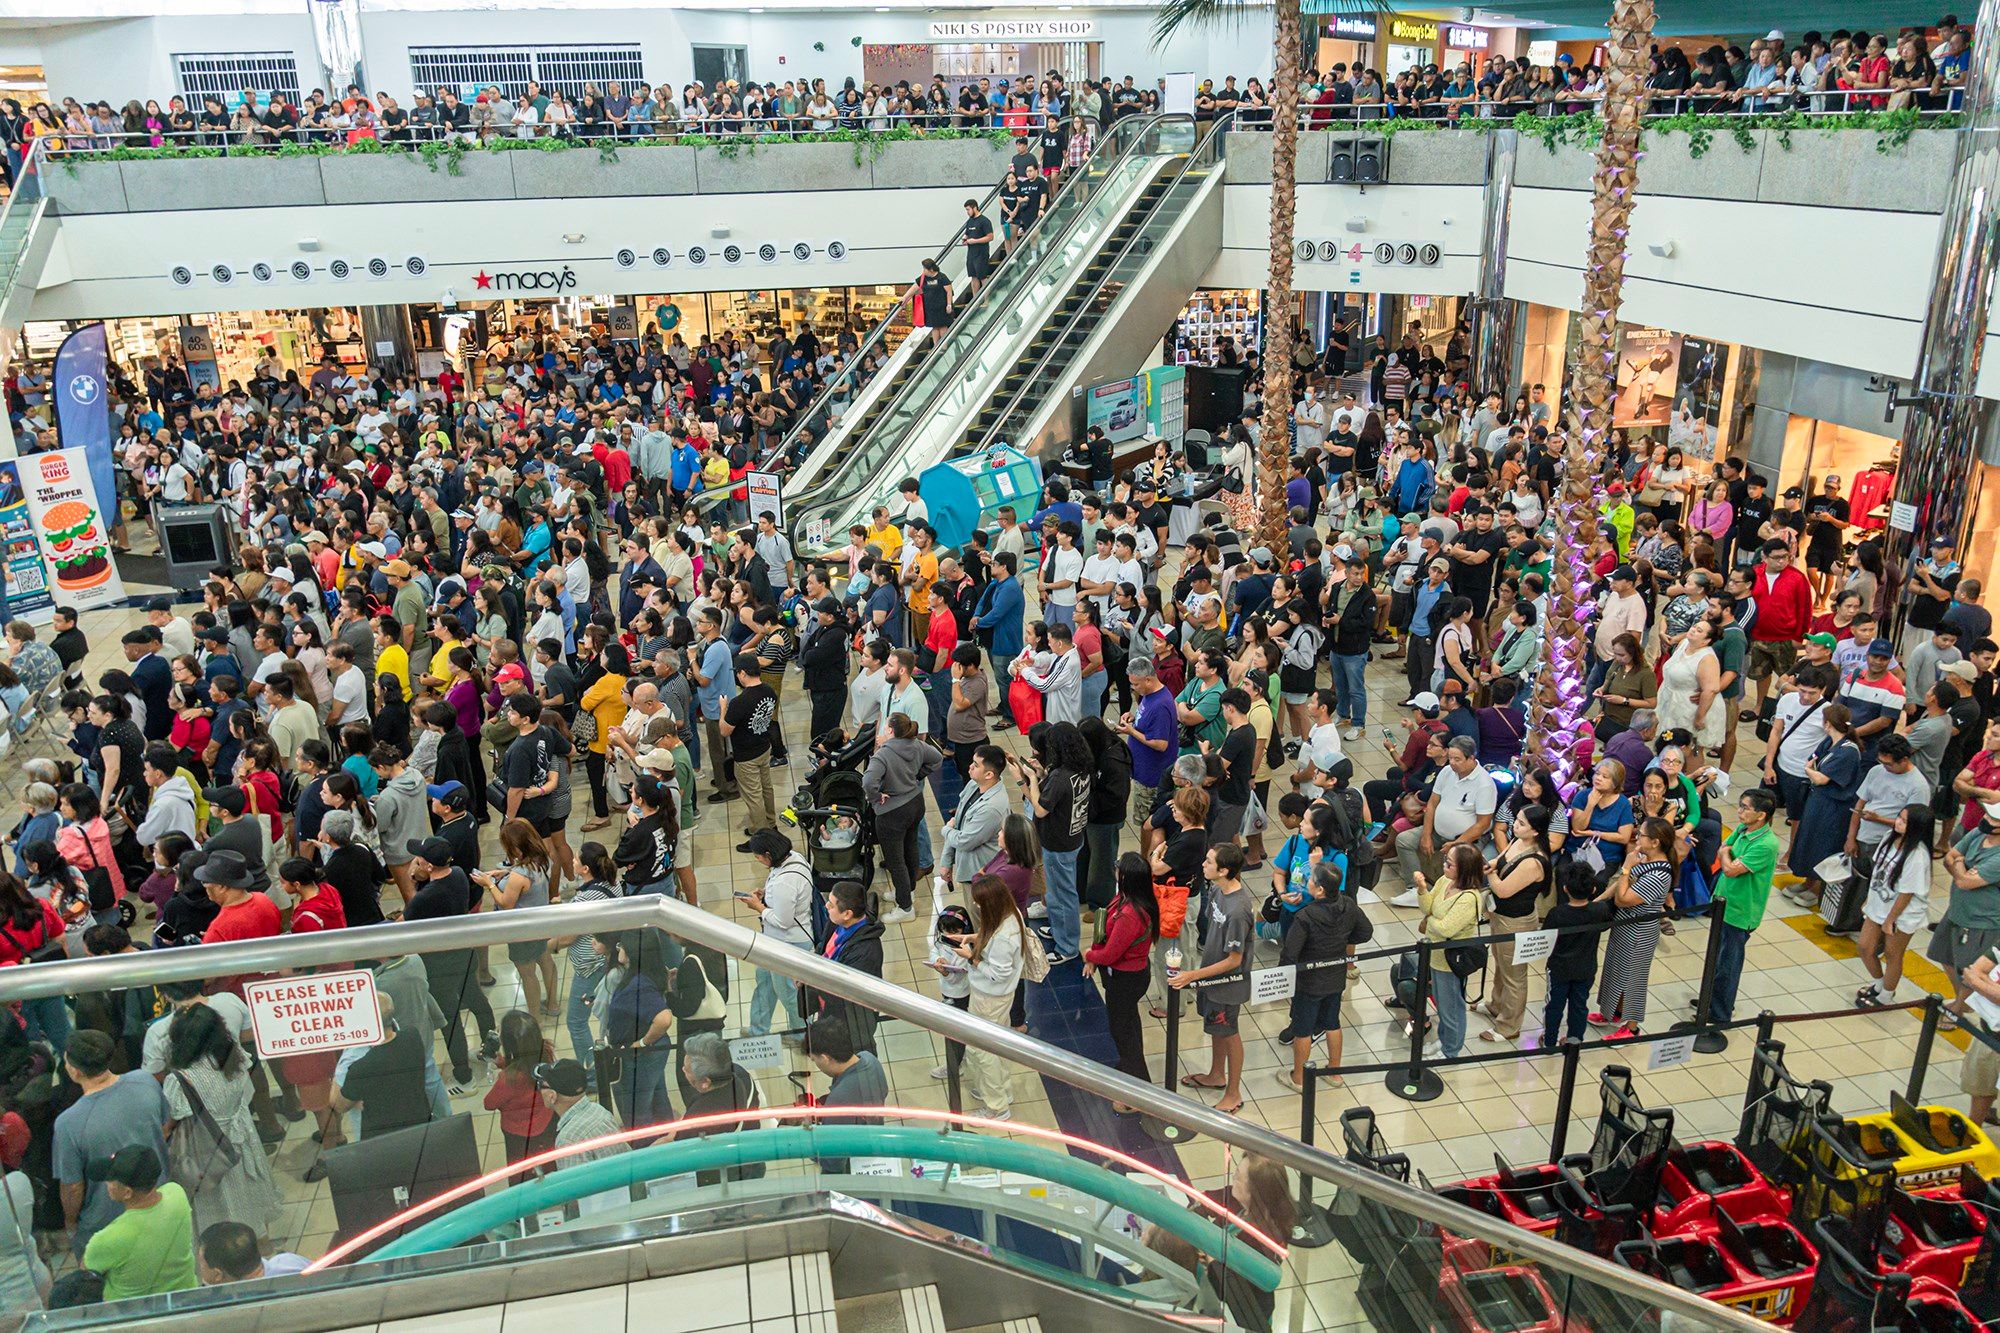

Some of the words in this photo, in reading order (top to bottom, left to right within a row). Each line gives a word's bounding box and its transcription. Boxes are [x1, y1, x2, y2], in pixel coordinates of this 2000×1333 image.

[986, 22, 1044, 34] PASTRY
[1049, 22, 1091, 34] SHOP
[1348, 243, 1363, 262] 4
[496, 265, 576, 293] macy's
[40, 461, 69, 471] BURGER
[42, 467, 70, 479] KING
[36, 487, 55, 496] THE
[1315, 957, 1345, 968] Micronesia
[1345, 955, 1359, 963] Mall
[1198, 976, 1230, 988] Micronesia
[1229, 974, 1244, 982] Mall
[1263, 972, 1284, 980] PLEASE
[254, 985, 317, 1004] PLEASE
[324, 978, 366, 995] KEEP
[273, 996, 354, 1019] STAIRWAY
[291, 1015, 345, 1034] CLEAR
[271, 1038, 296, 1050] FIRE
[300, 1035, 329, 1046] CODE
[333, 1029, 369, 1042] 25-109
